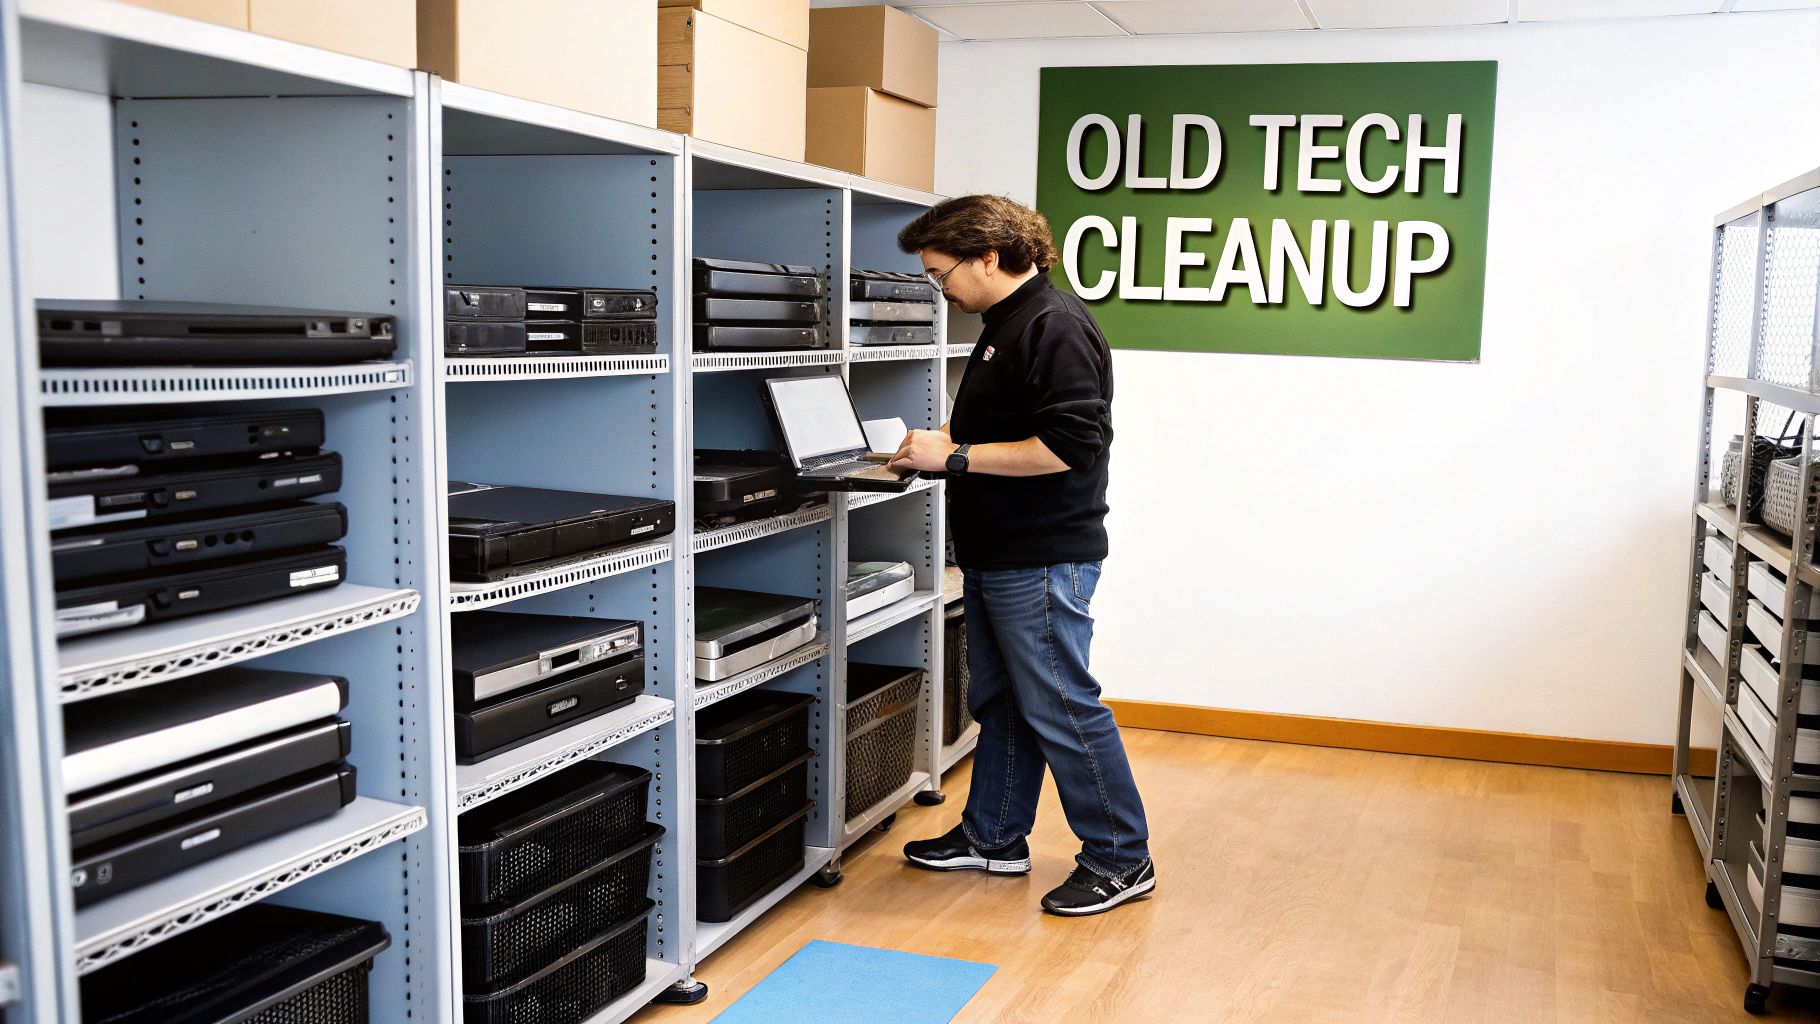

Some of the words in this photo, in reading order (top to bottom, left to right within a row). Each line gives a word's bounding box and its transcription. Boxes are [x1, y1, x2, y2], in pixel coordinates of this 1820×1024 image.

[1066, 113, 1222, 190] OLD
[1249, 112, 1462, 194] TECH
[1062, 215, 1450, 307] CLEANUP
